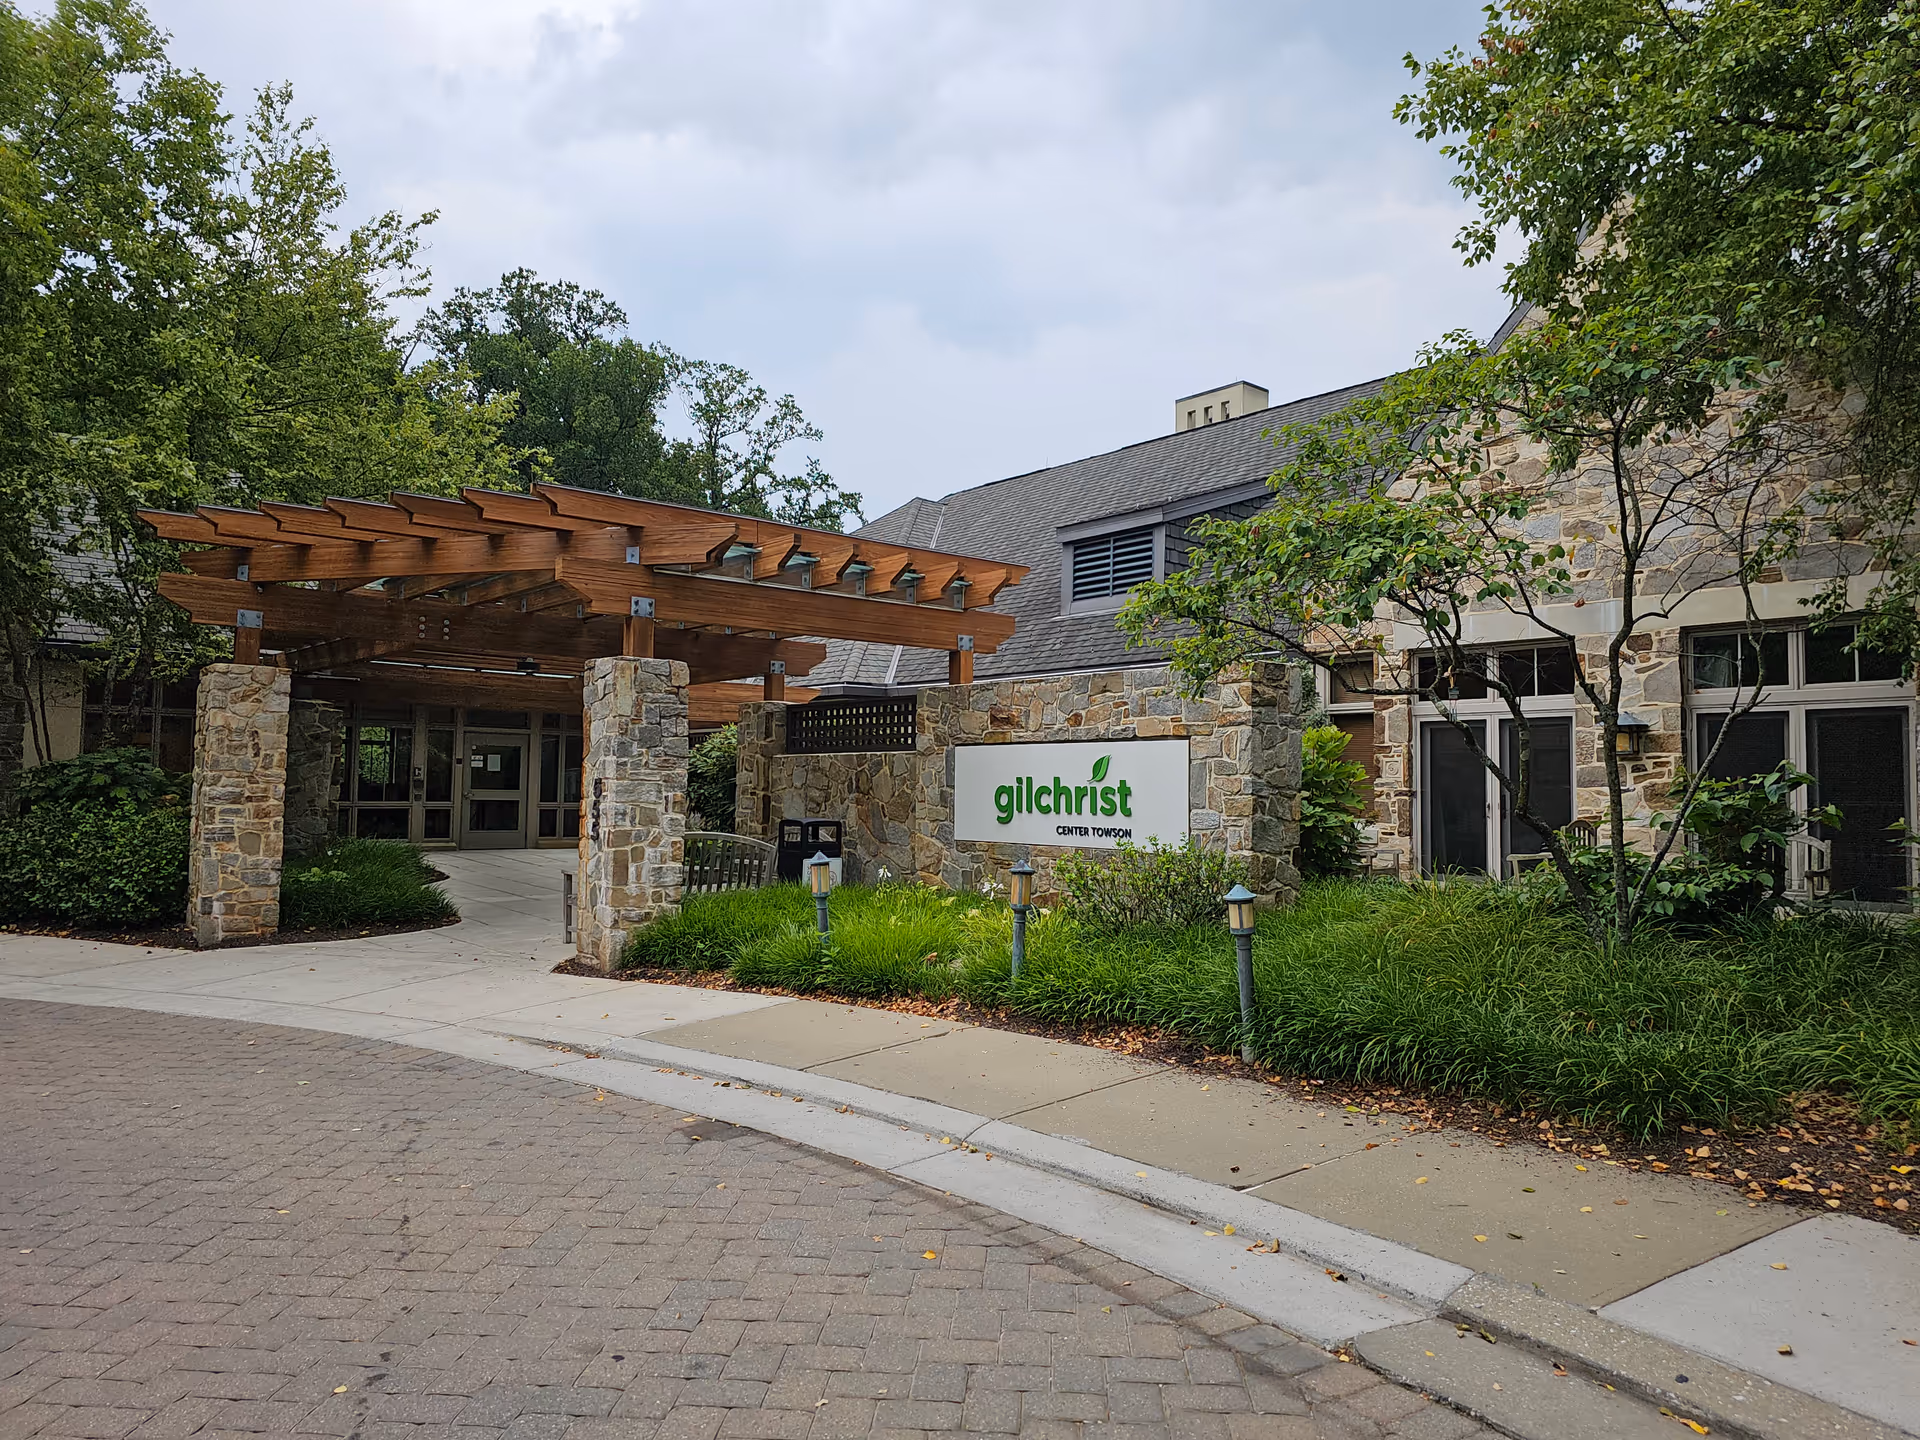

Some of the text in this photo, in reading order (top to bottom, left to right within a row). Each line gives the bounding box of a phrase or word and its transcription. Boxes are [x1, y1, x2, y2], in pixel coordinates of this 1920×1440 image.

[994, 776, 1132, 824] gilchrist
[1056, 825, 1132, 839] CENTER TOWSON
